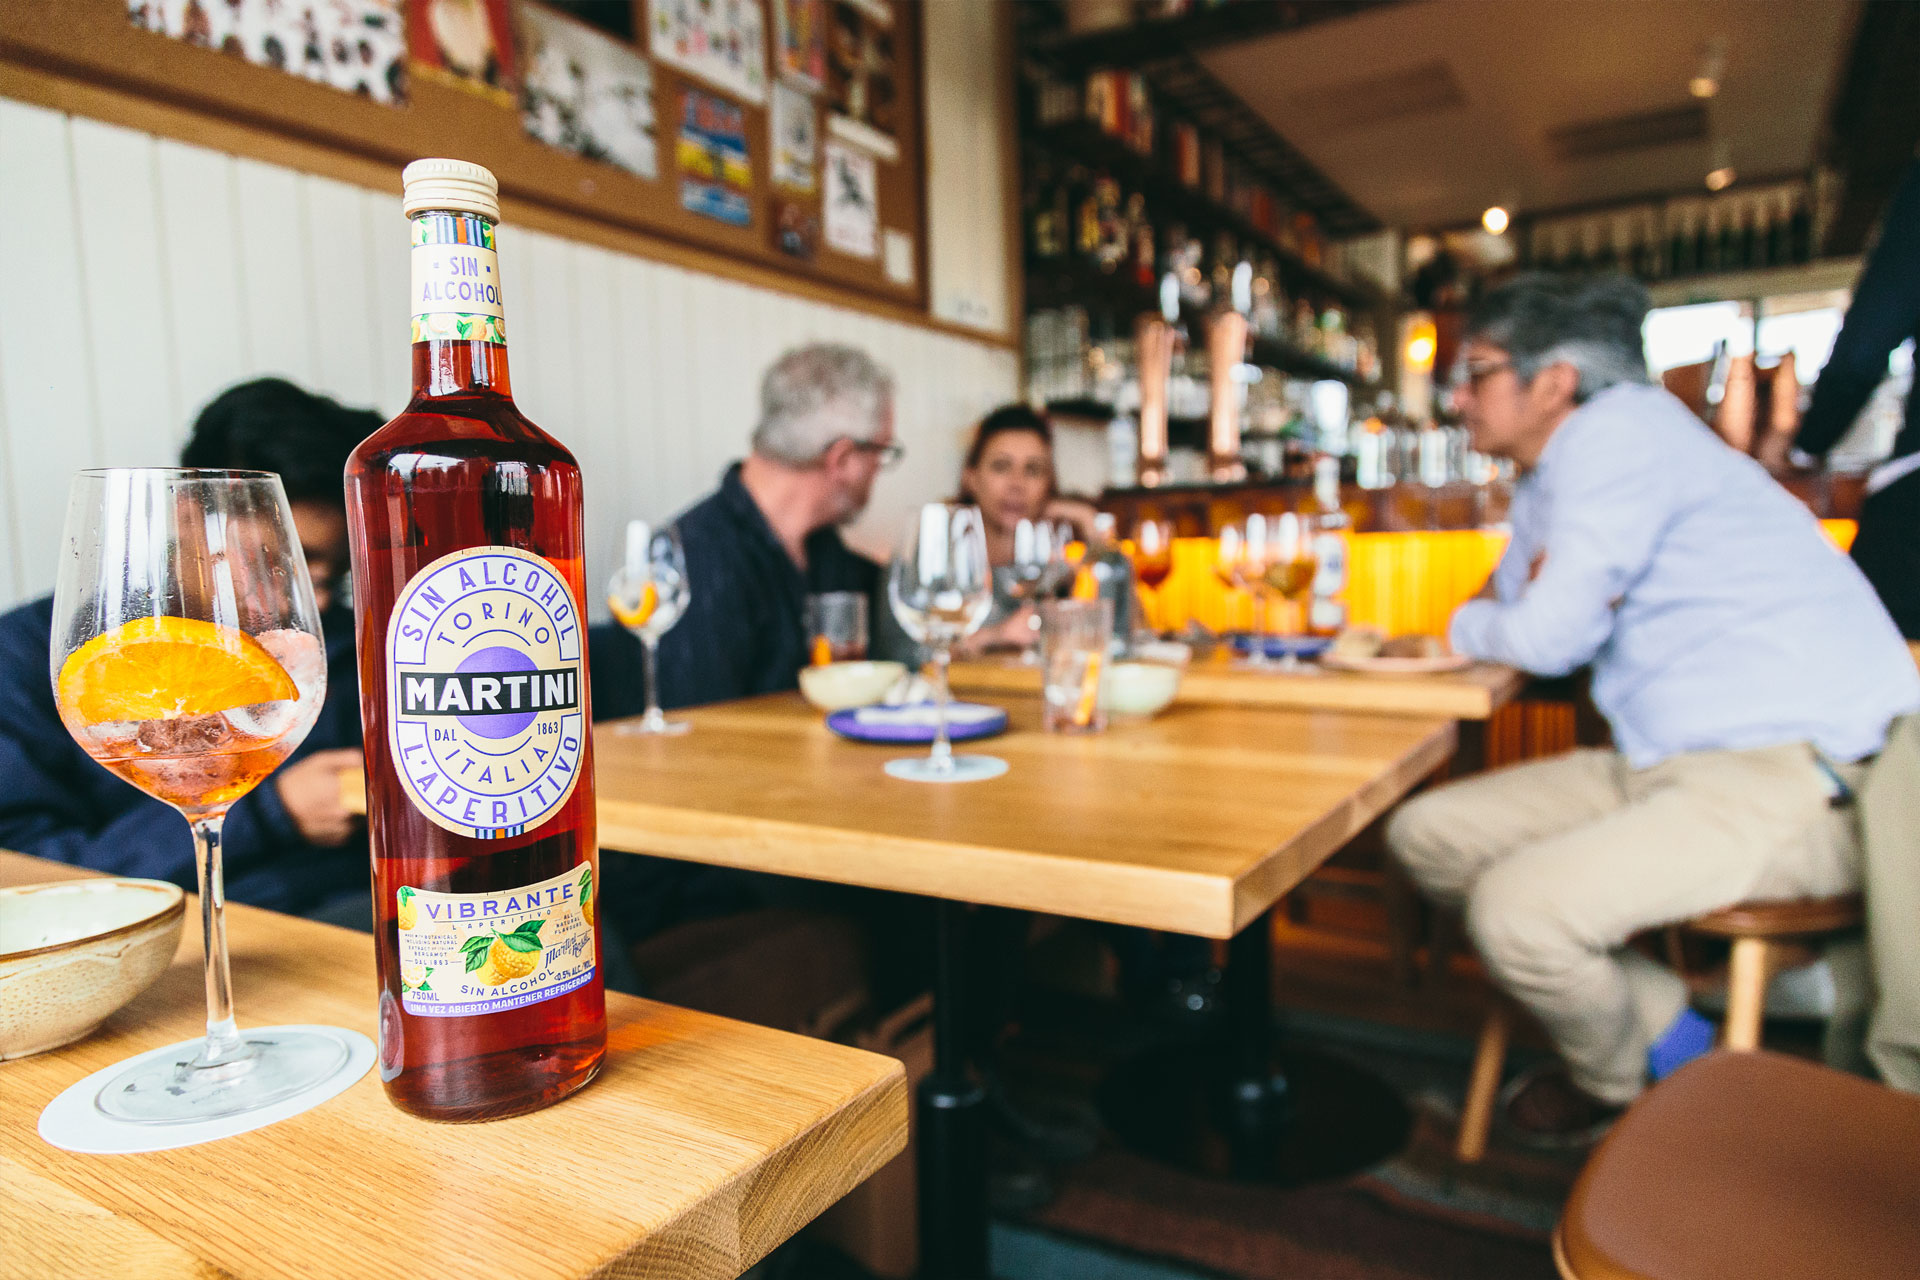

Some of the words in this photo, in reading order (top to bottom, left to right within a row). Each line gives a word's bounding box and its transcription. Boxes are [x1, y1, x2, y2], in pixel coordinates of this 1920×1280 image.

[449, 256, 479, 277] SIN
[422, 281, 502, 306] ALCOHOL
[402, 585, 447, 642] SIN
[458, 561, 576, 642] ALCOHOL
[436, 602, 551, 648] TORINO
[406, 672, 576, 712] MARTINI
[434, 728, 458, 742] DAL
[537, 721, 559, 736] 1863
[403, 735, 579, 825] L'APERITIVO
[445, 746, 549, 784] ITALIA
[425, 883, 574, 920] VIBRANTE
[410, 1003, 427, 1013] UNA
[428, 1003, 446, 1014] VEZ
[448, 1001, 490, 1014] ABIERTO
[491, 990, 543, 1010] MANTENER
[544, 972, 592, 998] REFRIGERADO
[411, 991, 440, 1001] 750ML
[460, 984, 485, 997] SIN
[491, 969, 556, 997] ALCOHOL
